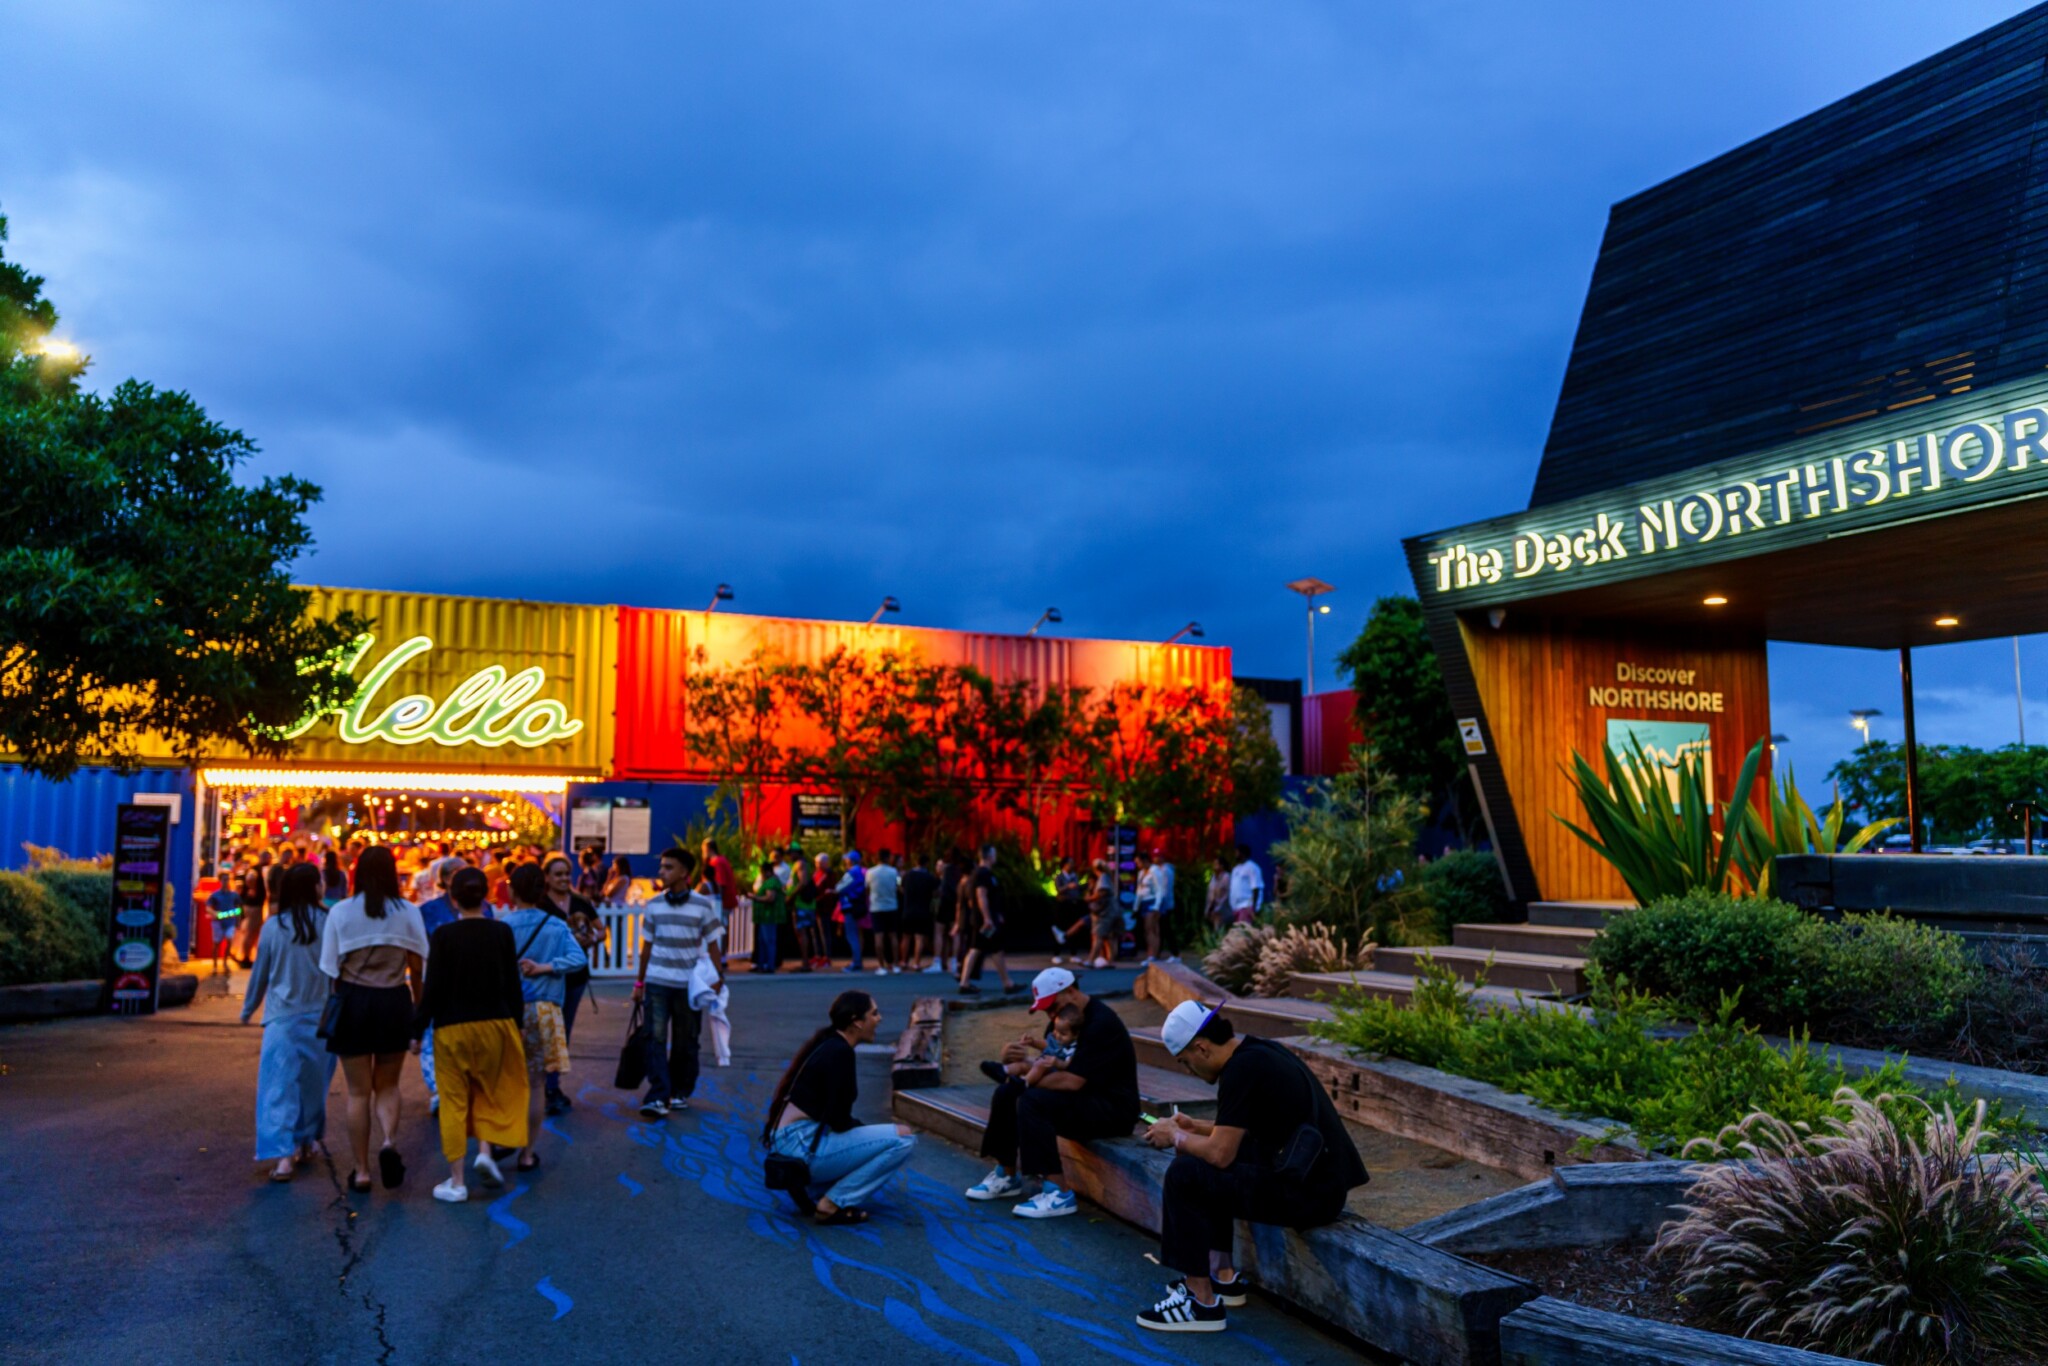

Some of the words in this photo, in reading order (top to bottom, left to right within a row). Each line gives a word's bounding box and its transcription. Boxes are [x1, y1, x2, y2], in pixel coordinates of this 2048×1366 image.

[1428, 544, 1504, 592] The
[1512, 513, 1628, 578] Deck
[1635, 407, 2048, 554] NORTHSHOR
[249, 632, 584, 748] Hello
[1589, 686, 1724, 712] NORTHSHORE
[1616, 662, 1696, 686] Discover
